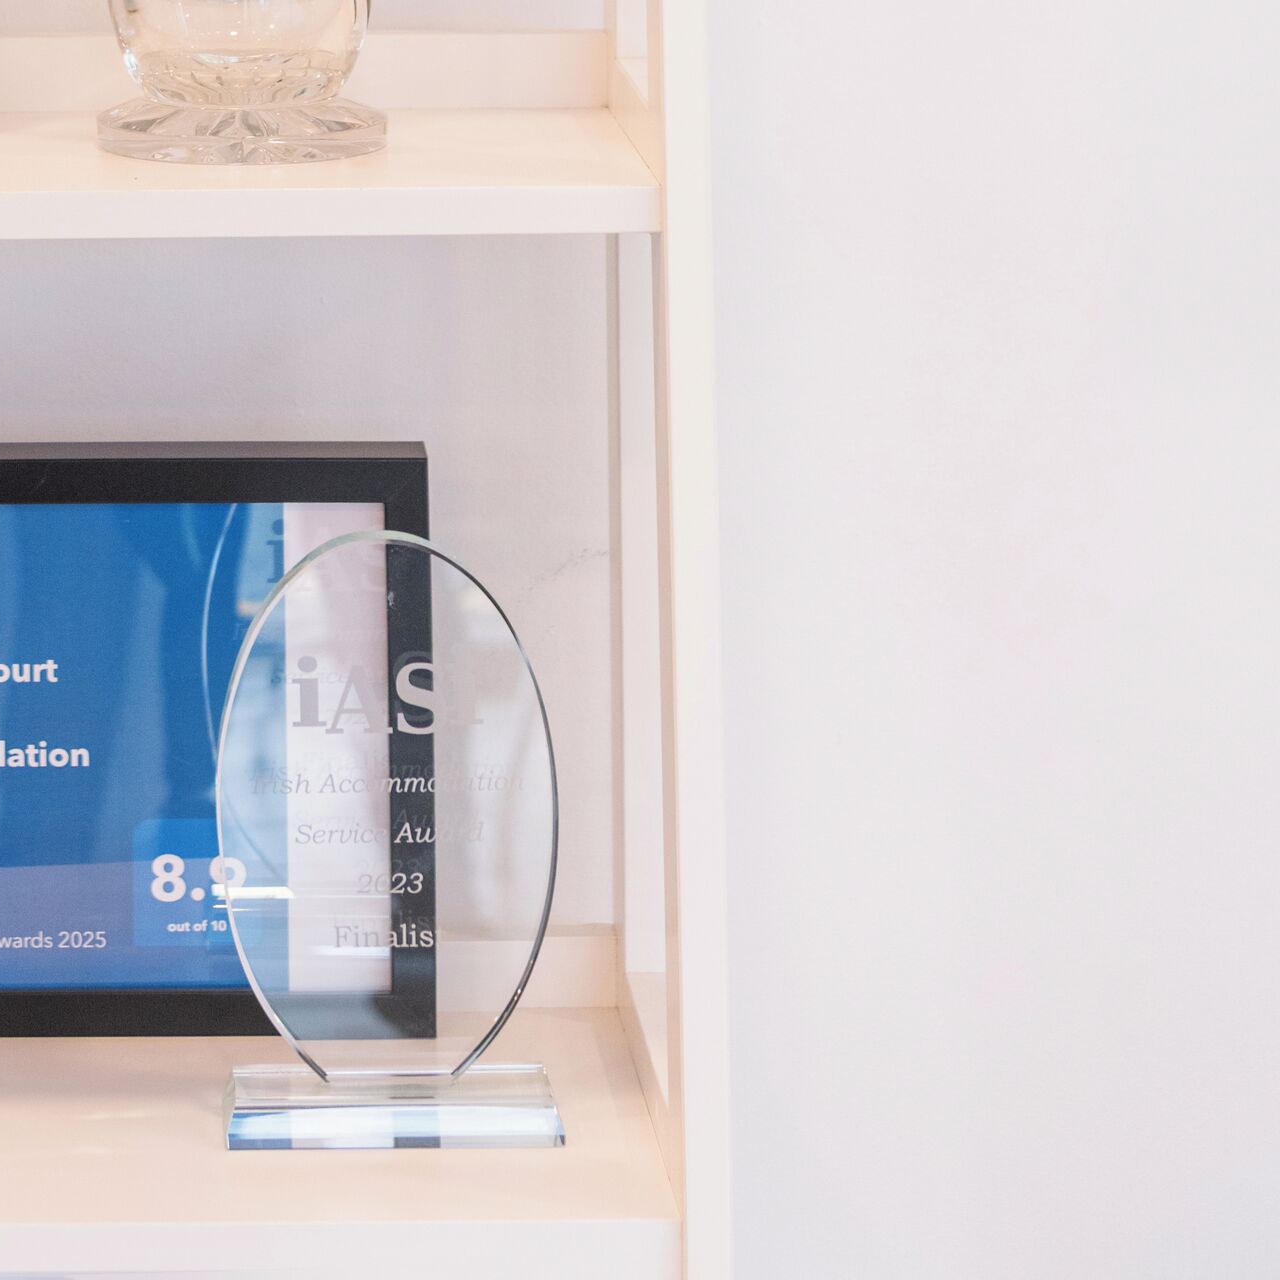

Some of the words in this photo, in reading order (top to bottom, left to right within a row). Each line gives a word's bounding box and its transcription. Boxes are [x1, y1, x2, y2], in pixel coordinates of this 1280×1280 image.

[319, 771, 524, 794] Accmmotion
[394, 822, 485, 844] Awd
[358, 872, 424, 894] 2023
[167, 921, 191, 932] out
[192, 920, 208, 932] of
[211, 920, 227, 931] 10
[334, 923, 442, 948] Finalis
[58, 931, 107, 948] 2025
